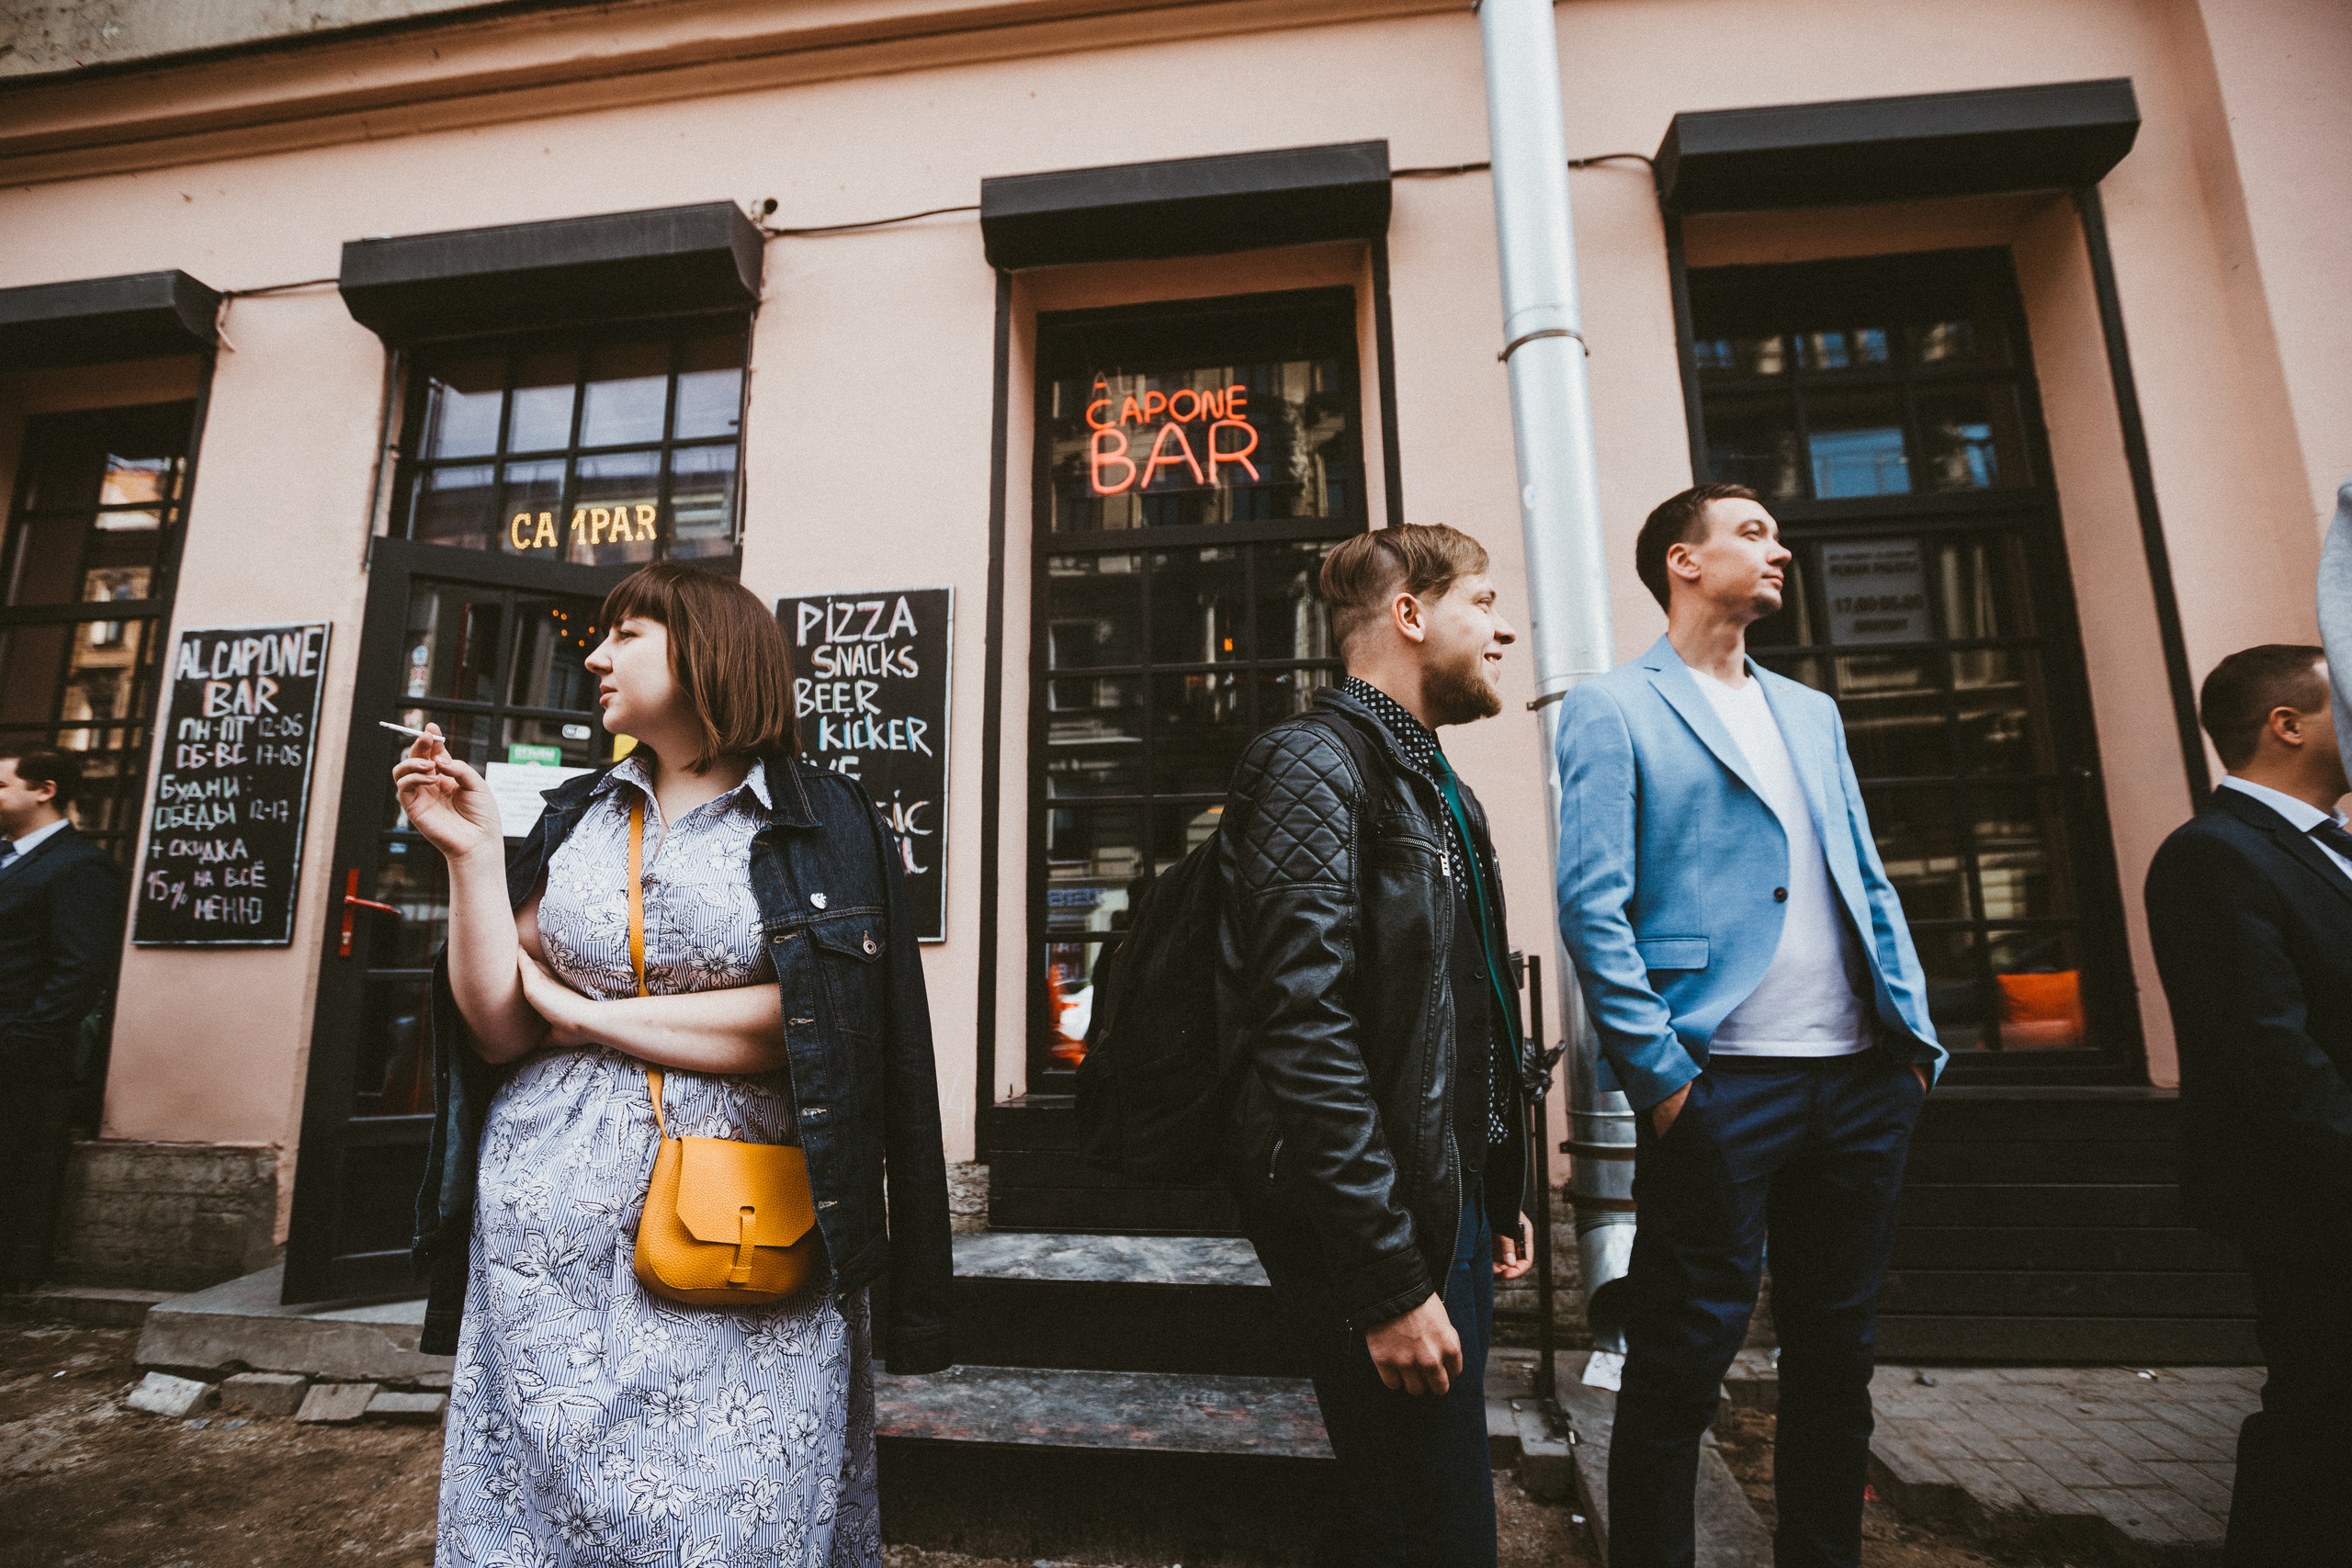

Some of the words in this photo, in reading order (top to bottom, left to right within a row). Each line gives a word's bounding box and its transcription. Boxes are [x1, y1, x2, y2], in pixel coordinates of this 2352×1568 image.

[1086, 385, 1248, 430] CAPONE
[1091, 419, 1260, 494] BAR
[175, 639, 209, 681] AL
[211, 626, 324, 680] CAPONE
[203, 676, 278, 717] BAR
[794, 678, 882, 718] BEER
[175, 742, 248, 769] СБ-ВС
[250, 798, 289, 823] 12-17
[193, 870, 215, 888] НА
